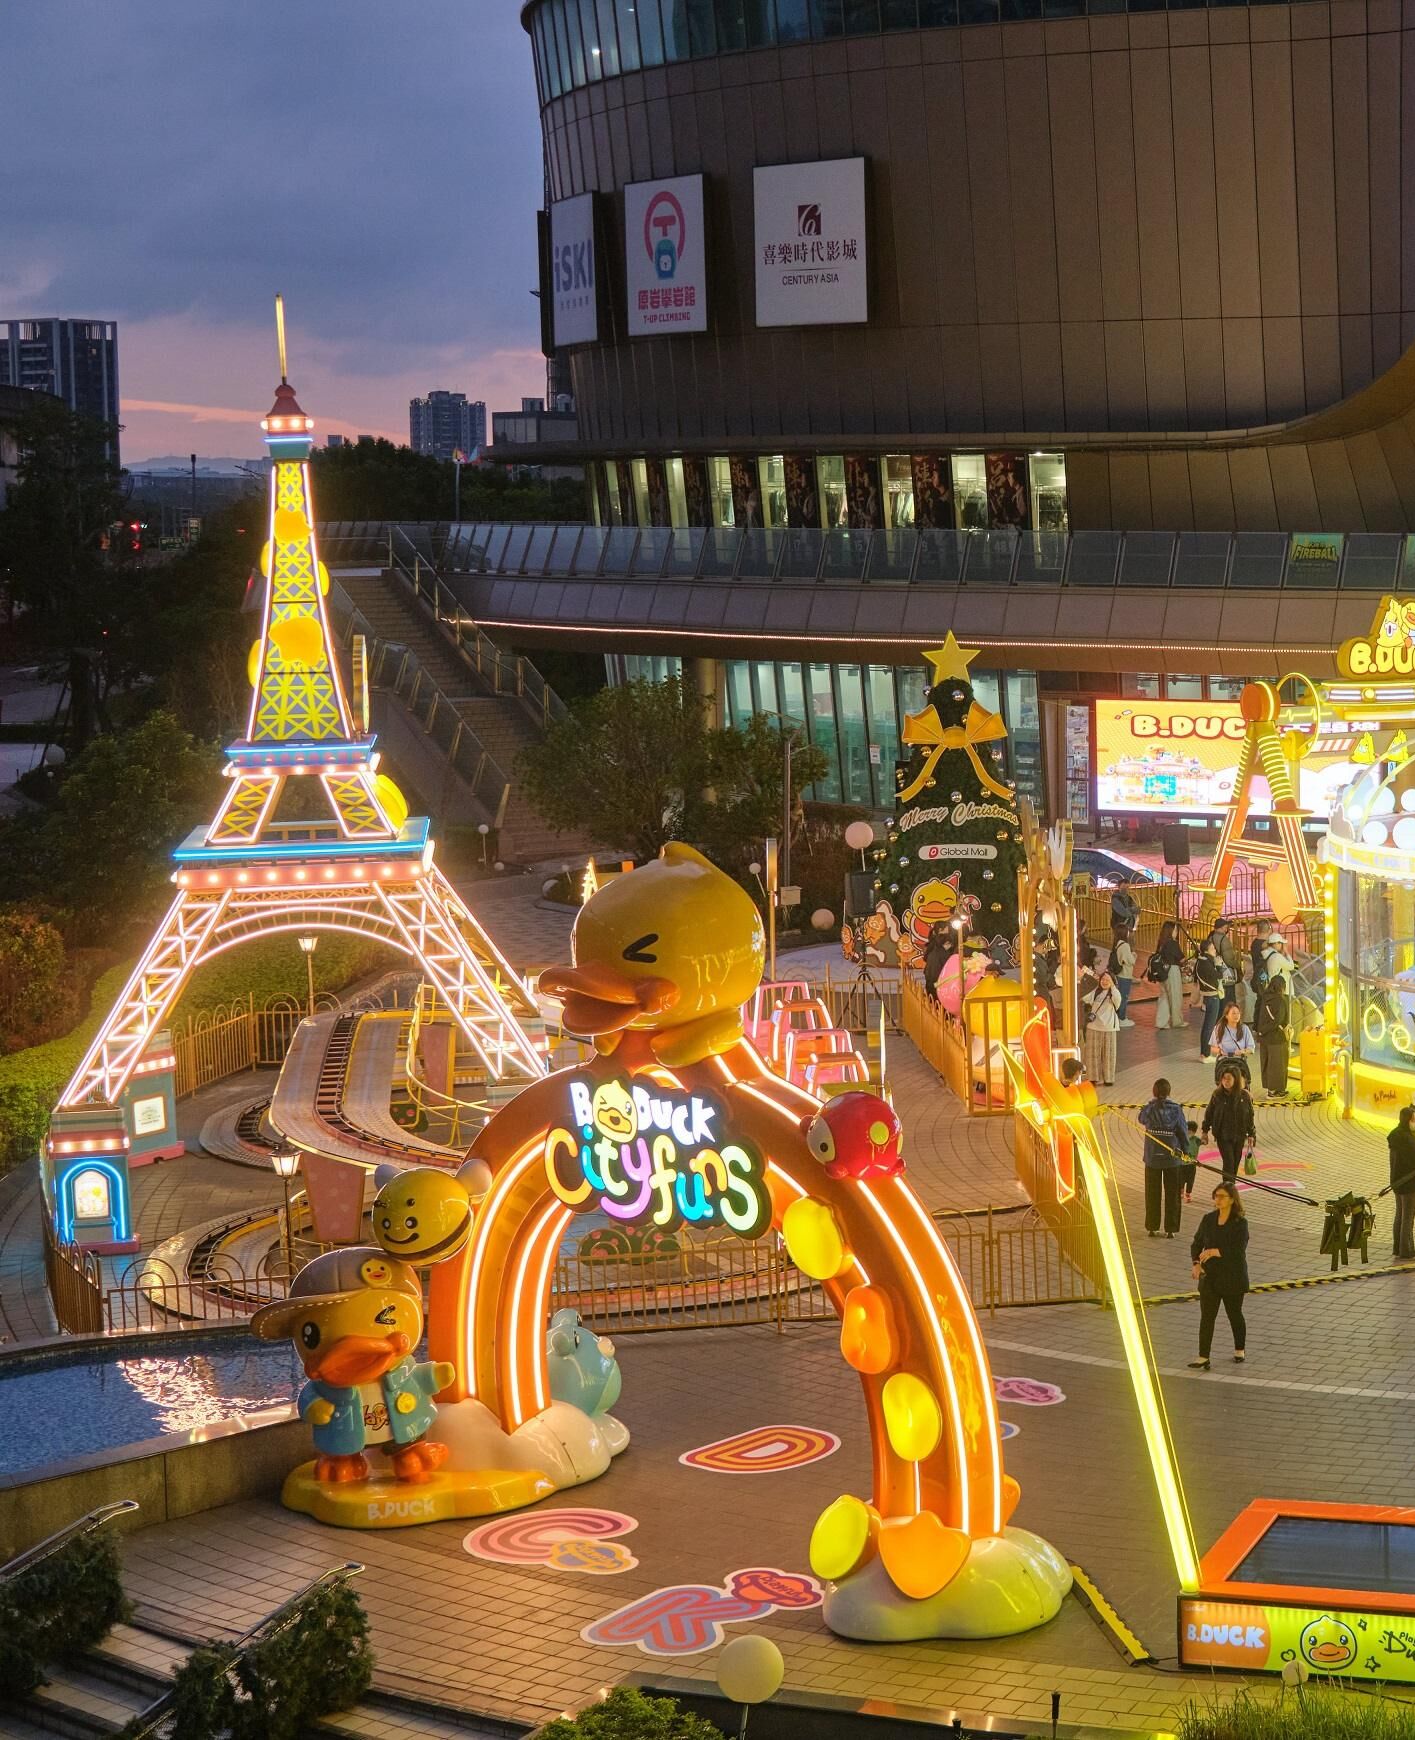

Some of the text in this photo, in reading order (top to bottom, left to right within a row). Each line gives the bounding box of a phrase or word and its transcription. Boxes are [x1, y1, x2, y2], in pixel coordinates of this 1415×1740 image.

[762, 239, 858, 265] 喜樂時代影城
[554, 238, 593, 293] iSKI
[782, 273, 840, 286] CENTURY ASIA
[643, 311, 691, 325] T-UP CLIMBING
[1291, 544, 1338, 561] FIREBALL
[1130, 714, 1247, 740] B.DUC
[900, 802, 1019, 832] Merry Christmas
[940, 847, 988, 857] Global Mall
[545, 1124, 759, 1232] Cityfuns
[367, 1498, 435, 1521] B.DUCK
[1187, 1623, 1265, 1649] B.DUCK
